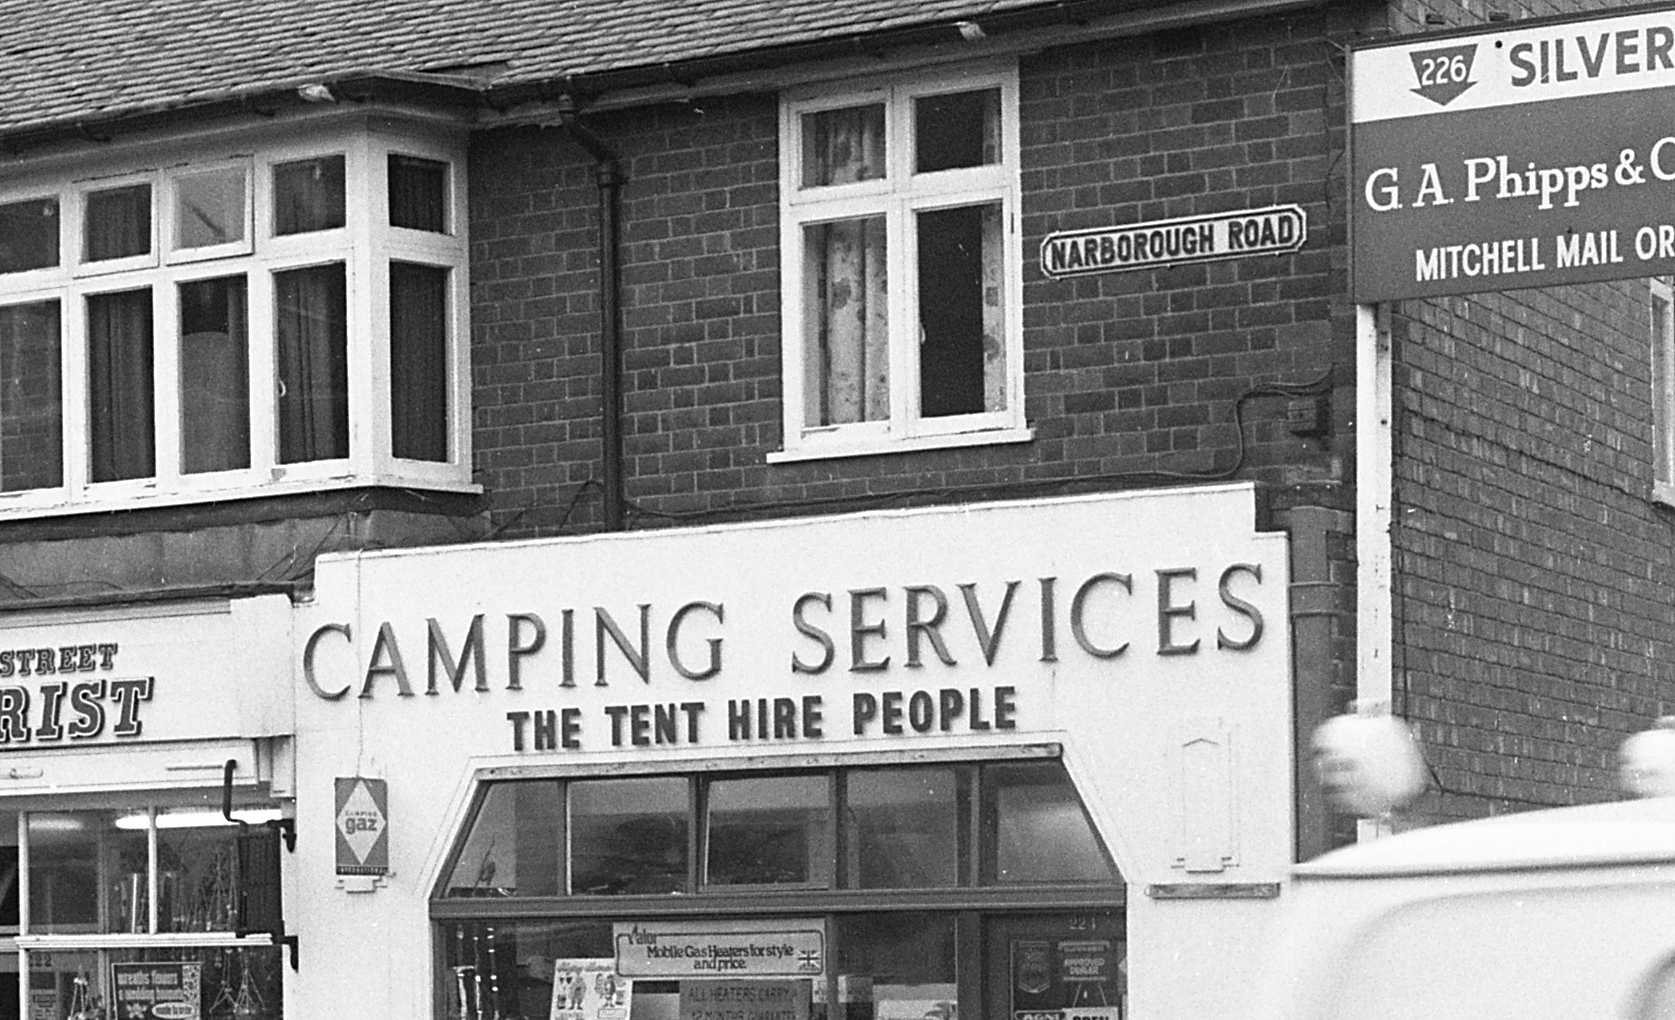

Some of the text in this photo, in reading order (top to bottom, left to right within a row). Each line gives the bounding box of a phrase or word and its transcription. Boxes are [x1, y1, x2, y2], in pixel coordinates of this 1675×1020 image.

[1422, 26, 1675, 87] 226 SILVER
[1464, 155, 1608, 209] Phipps
[1615, 148, 1645, 185] &
[1051, 215, 1294, 271] NARBOROUGH ROAD
[1416, 238, 1545, 281] MITCHELL
[1556, 230, 1623, 268] MAIL
[303, 563, 1264, 701] CAMPING SERVICES
[506, 685, 1017, 752] THE TENT HIRE PEOPLE
[345, 817, 378, 835] gaz
[627, 924, 657, 945] Valor
[646, 943, 795, 960] Mobile Gas Heaters for style
[694, 957, 717, 971] and
